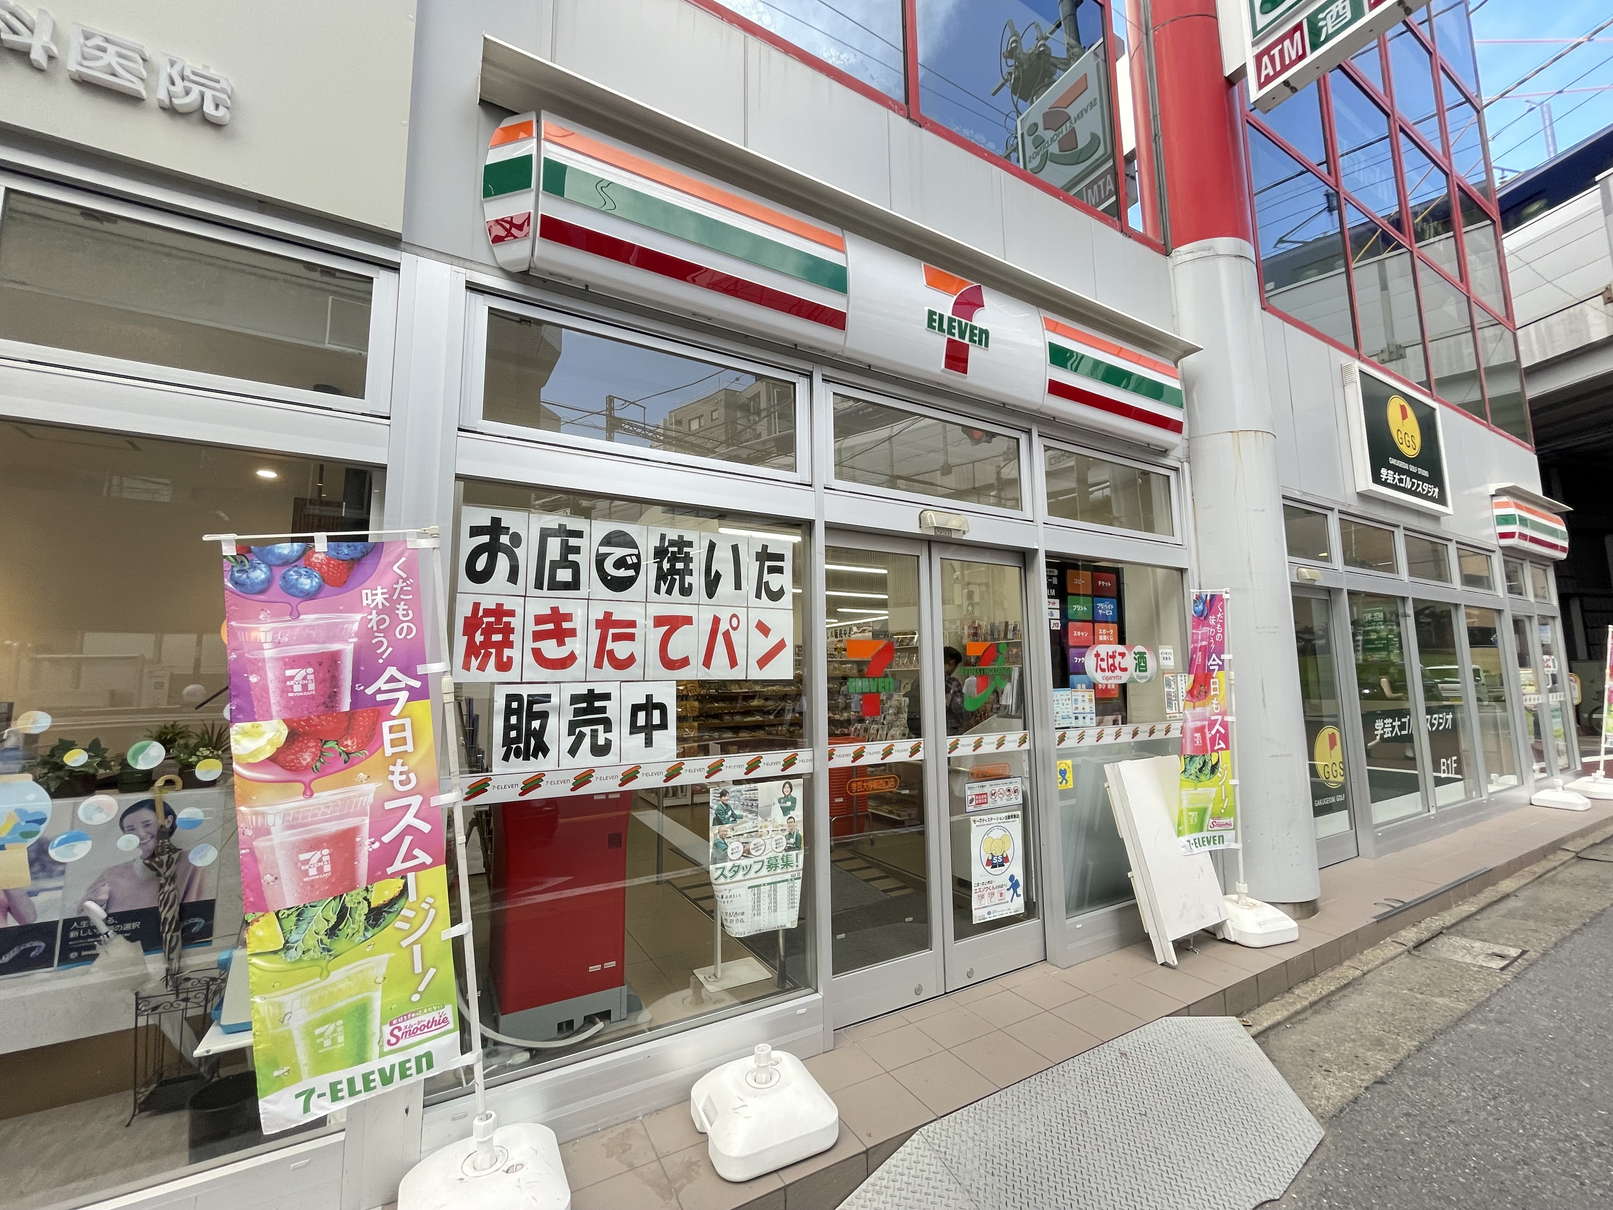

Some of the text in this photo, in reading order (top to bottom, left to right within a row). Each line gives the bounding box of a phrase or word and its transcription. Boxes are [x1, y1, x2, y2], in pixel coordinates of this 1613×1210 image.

[1318, 0, 1352, 41] 酒
[1260, 30, 1303, 83] ATM
[1396, 428, 1417, 450] GGS
[1380, 467, 1440, 499] 学芸大ゴルフスタジオ
[464, 515, 786, 602] お店で焼いた
[391, 556, 417, 640] くだもの
[361, 585, 393, 664] 味わう！
[461, 601, 788, 673] 焼きたてパン
[1093, 649, 1129, 673] たばこ
[1133, 650, 1148, 673] 酒
[500, 687, 669, 763] 販売中
[1323, 760, 1345, 780] GGS
[1440, 756, 1458, 778] B1F
[364, 665, 437, 1002] 今日もスムージー！
[714, 852, 800, 881] スタッフ募集！
[386, 1015, 450, 1047] Smoothie
